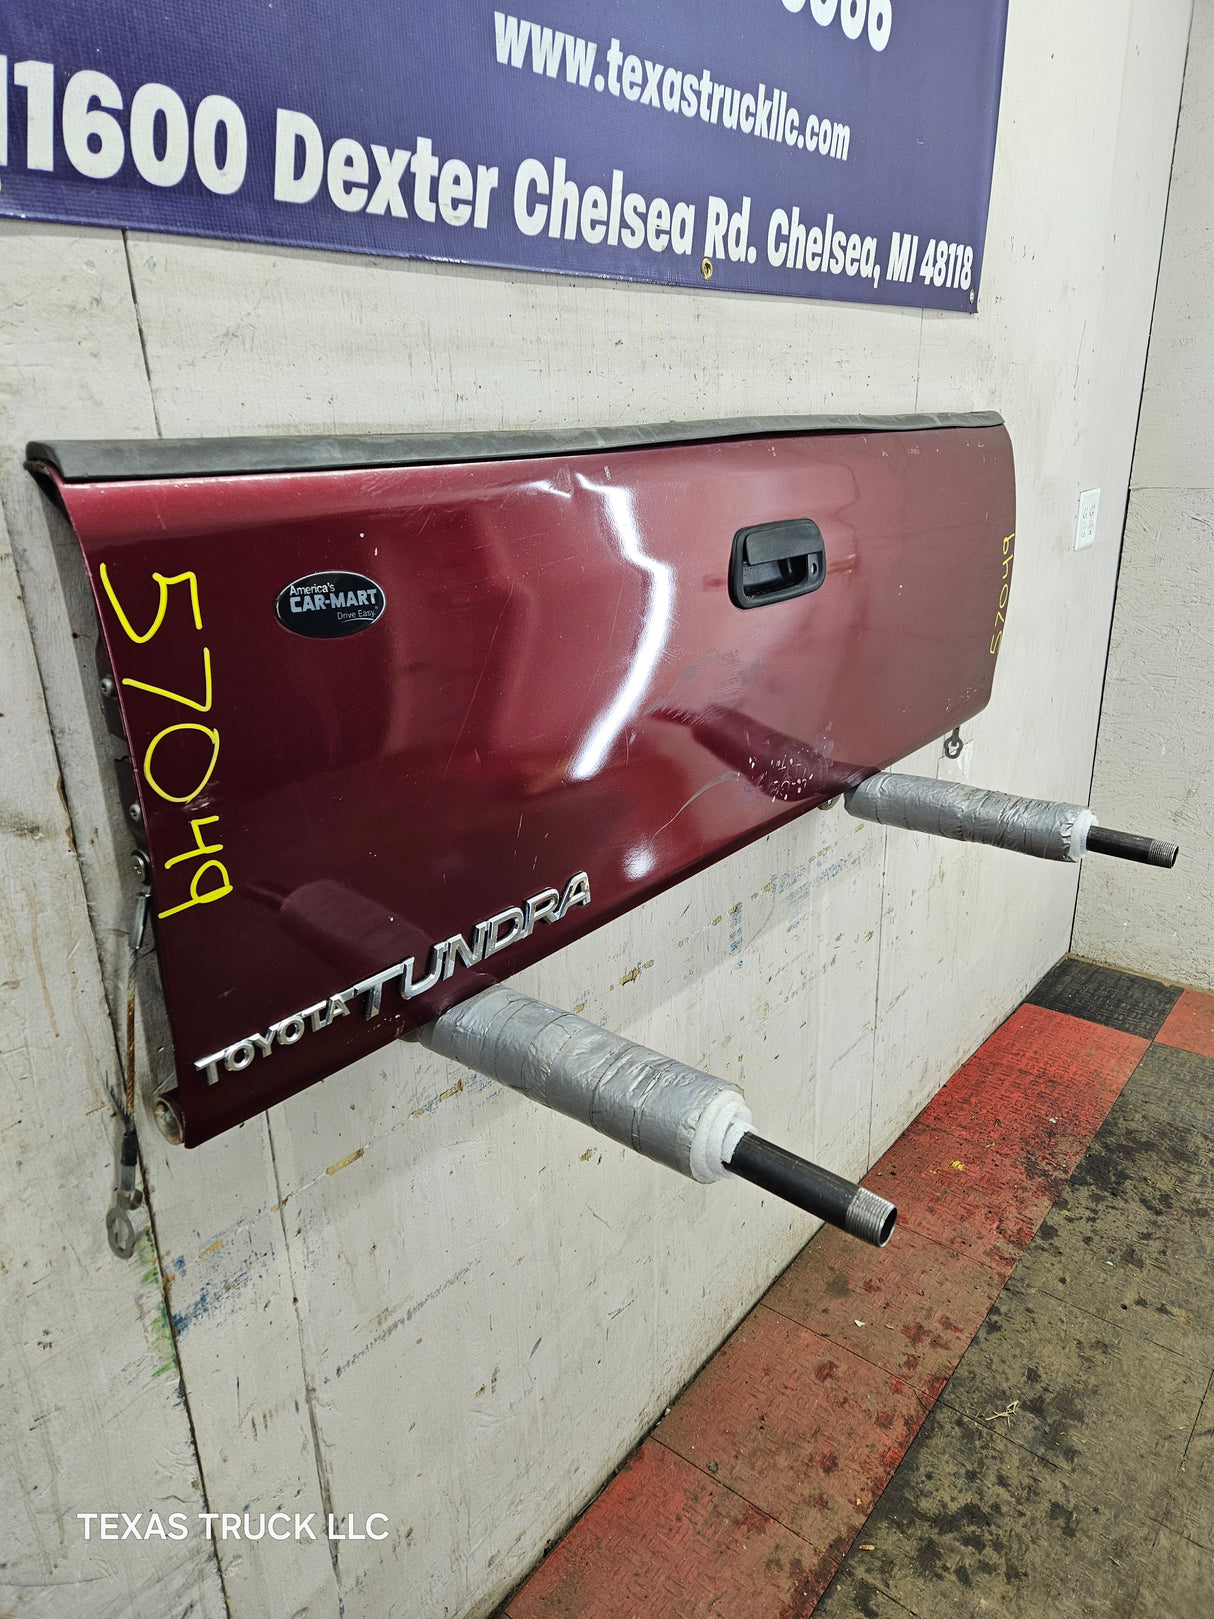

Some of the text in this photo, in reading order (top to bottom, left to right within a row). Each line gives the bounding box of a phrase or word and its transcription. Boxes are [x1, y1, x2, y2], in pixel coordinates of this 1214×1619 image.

[494, 11, 851, 162] www.texastruckllc.com
[0, 54, 974, 291] 1600 Dexter Chelsea Rd. Chelsea, MI 48118
[289, 582, 336, 596] America's
[289, 588, 377, 613] CAR-MART
[336, 610, 357, 620] Drive
[989, 533, 1015, 655] 57049
[99, 562, 233, 919] 57049
[193, 870, 592, 1086] TOYOTA TUNDRA
